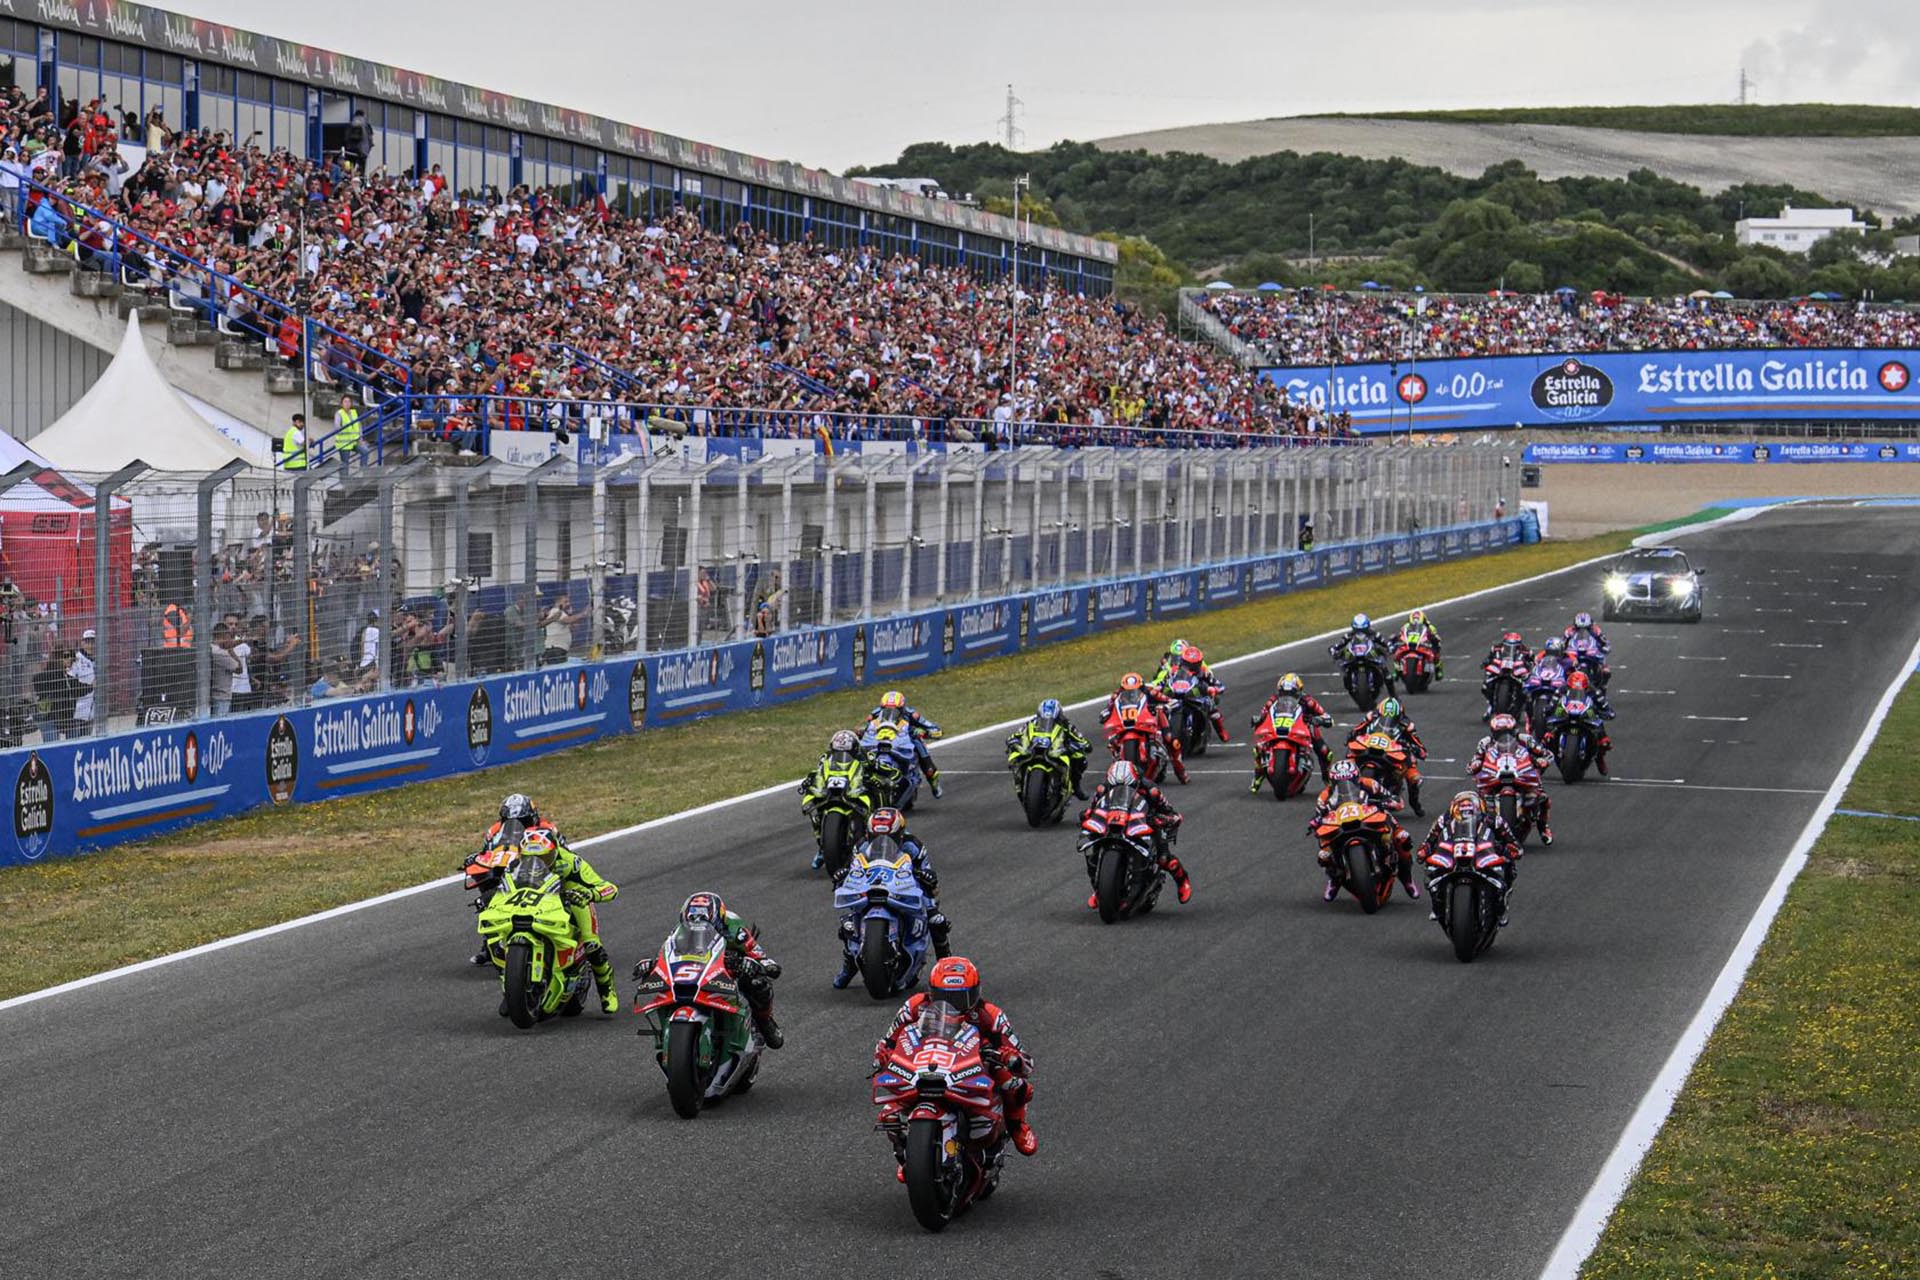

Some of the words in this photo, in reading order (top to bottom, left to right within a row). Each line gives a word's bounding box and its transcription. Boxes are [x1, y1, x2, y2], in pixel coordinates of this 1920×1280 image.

[1544, 375, 1601, 391] Estrella
[1637, 362, 1754, 393] Estrella
[1760, 360, 1869, 391] Galicia
[1286, 375, 1388, 411] Galicia
[1451, 371, 1486, 399] 0,0
[1546, 389, 1599, 406] Galicia
[656, 658, 685, 695] Estrella
[503, 678, 541, 724] Estrella
[541, 671, 575, 716] Galicia
[1122, 707, 1138, 720] 10
[312, 708, 360, 758] Estrella
[361, 700, 401, 751] Galicia
[271, 735, 293, 759] Estrella
[72, 747, 131, 803] Estrella
[131, 734, 181, 792] Galicia
[209, 730, 225, 777] 0,0
[271, 756, 293, 781] Galicia
[20, 778, 48, 807] Estrella
[20, 807, 47, 831] Galicia
[1339, 805, 1360, 820] 23
[491, 850, 518, 868] 37
[504, 887, 546, 907] 49
[887, 1062, 914, 1080] Lenovo
[951, 1065, 983, 1081] Lenovo
